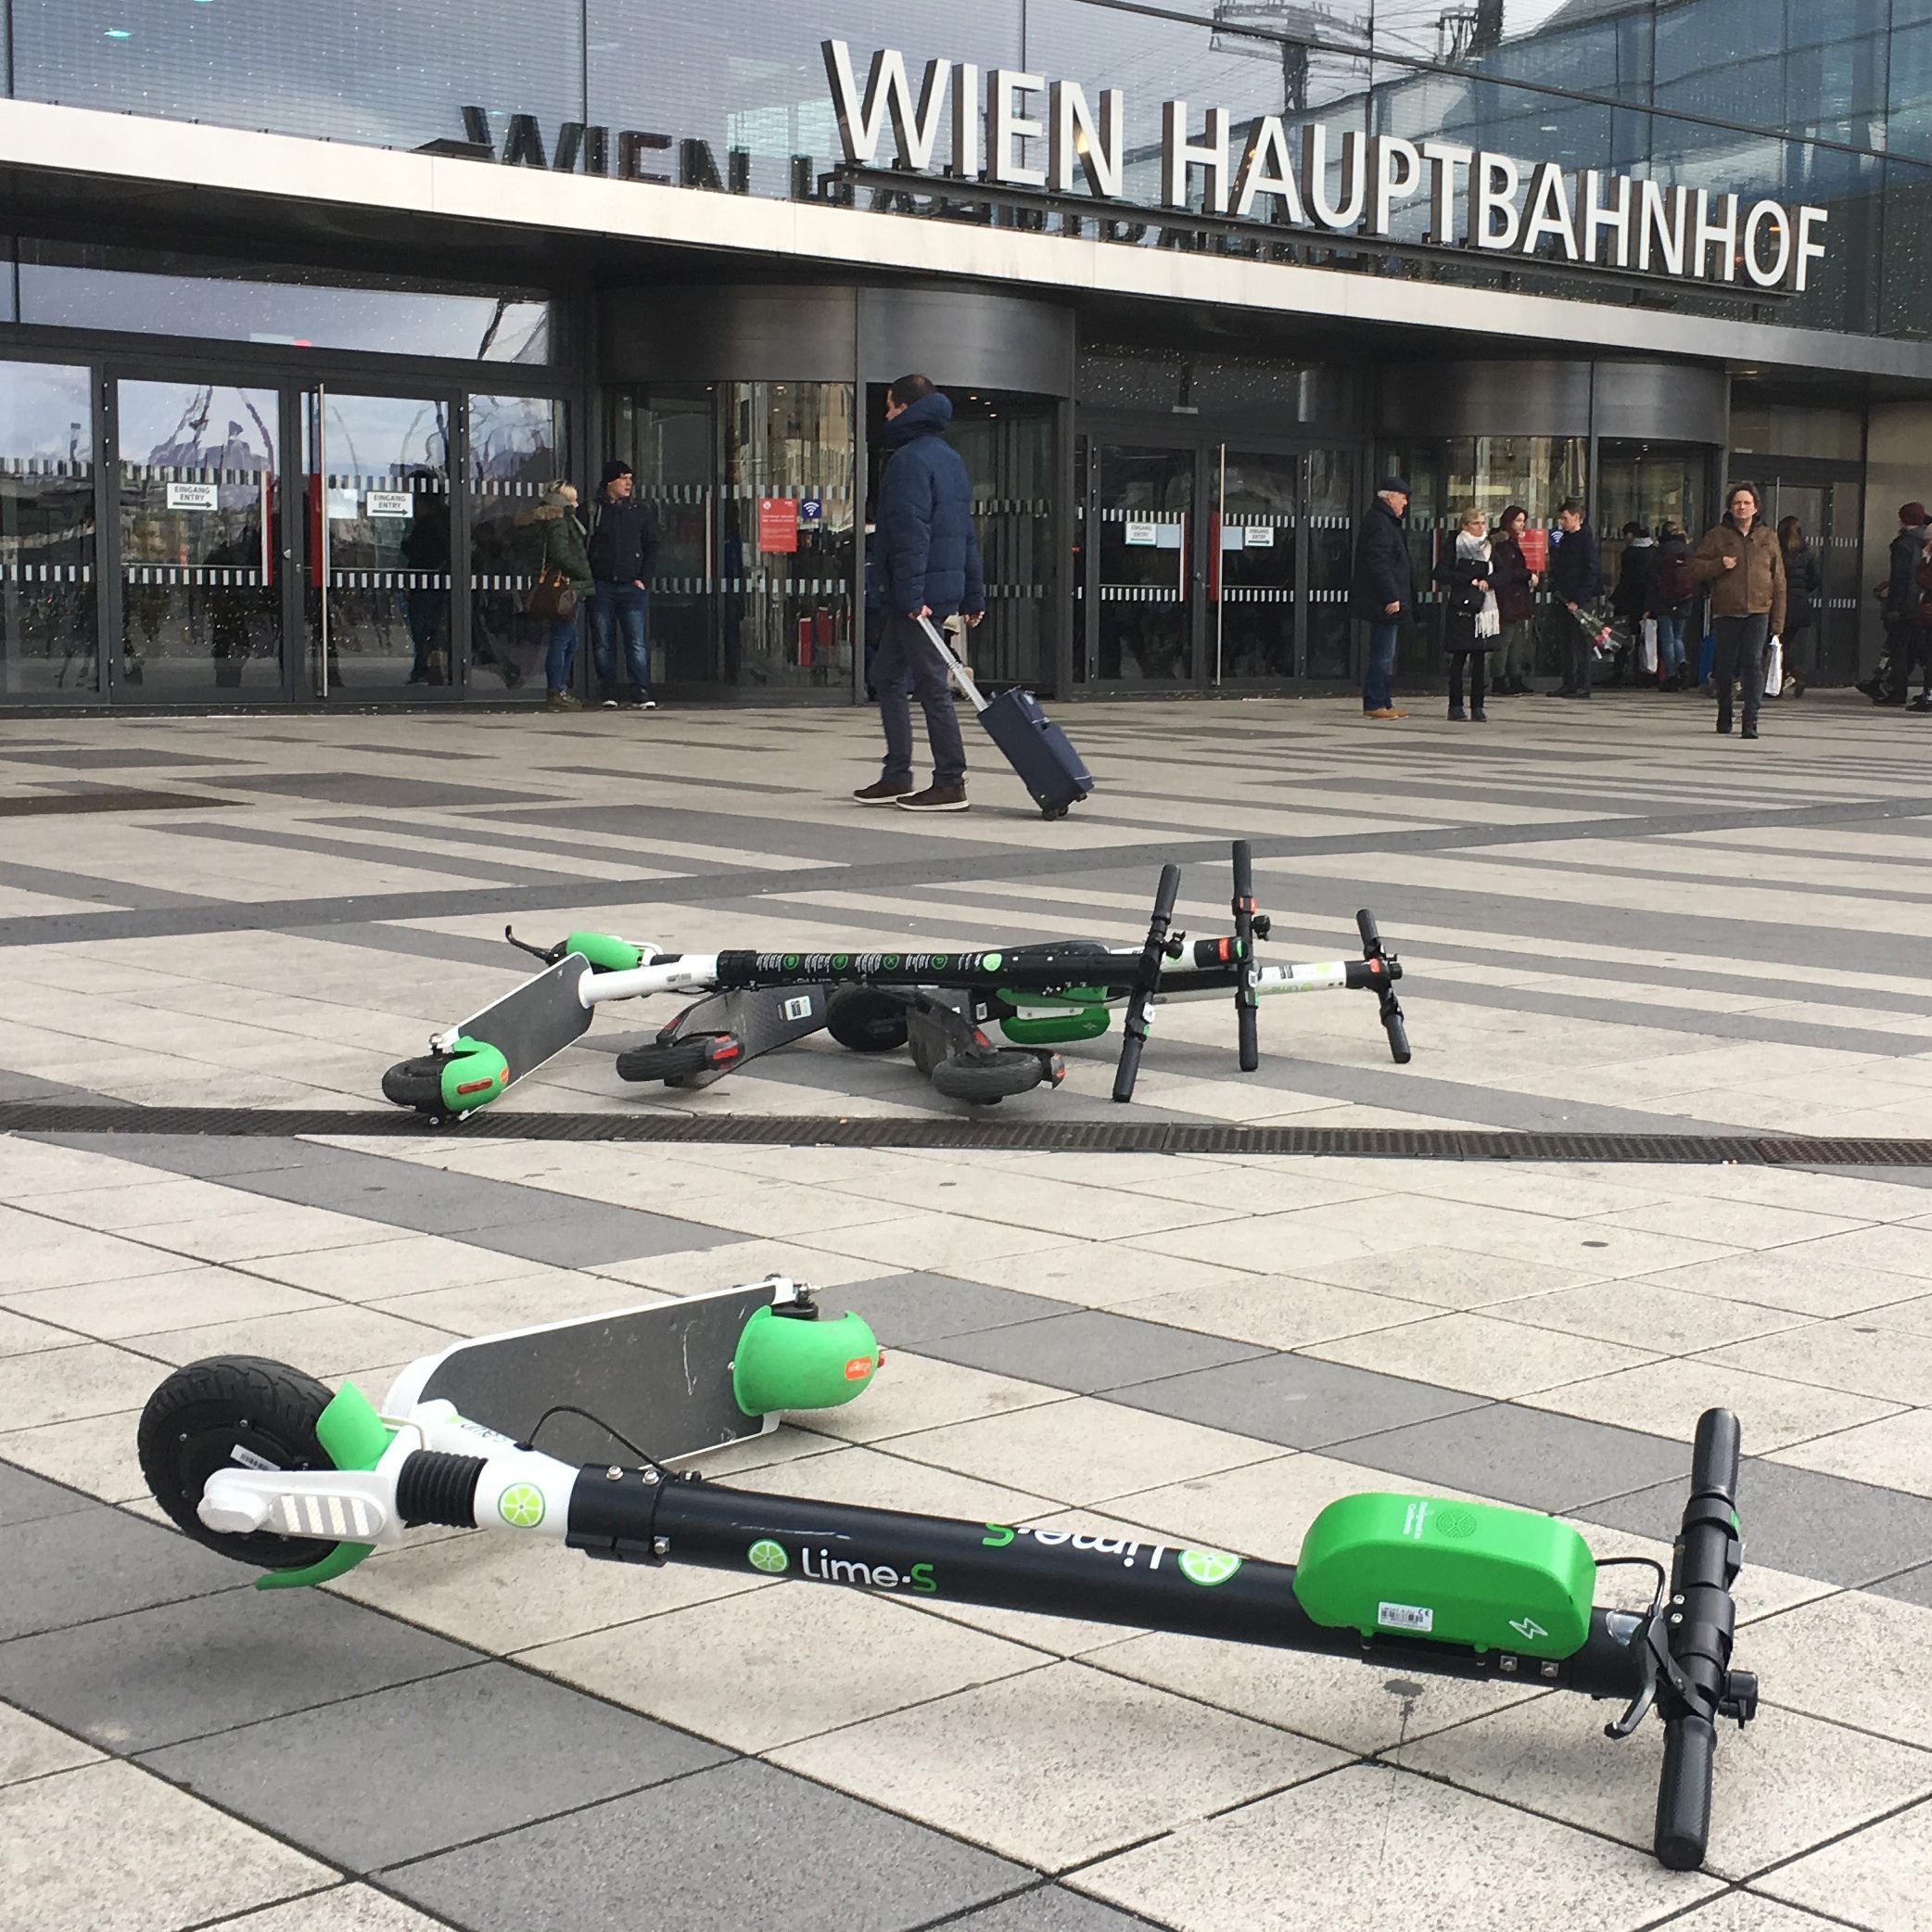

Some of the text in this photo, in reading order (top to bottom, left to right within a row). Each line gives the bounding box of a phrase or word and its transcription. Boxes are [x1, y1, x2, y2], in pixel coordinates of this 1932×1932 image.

[821, 39, 1828, 291] WIEN HAUPTBAHNHOF
[174, 486, 210, 494] EINGANG
[802, 1547, 937, 1593] Lime-S
